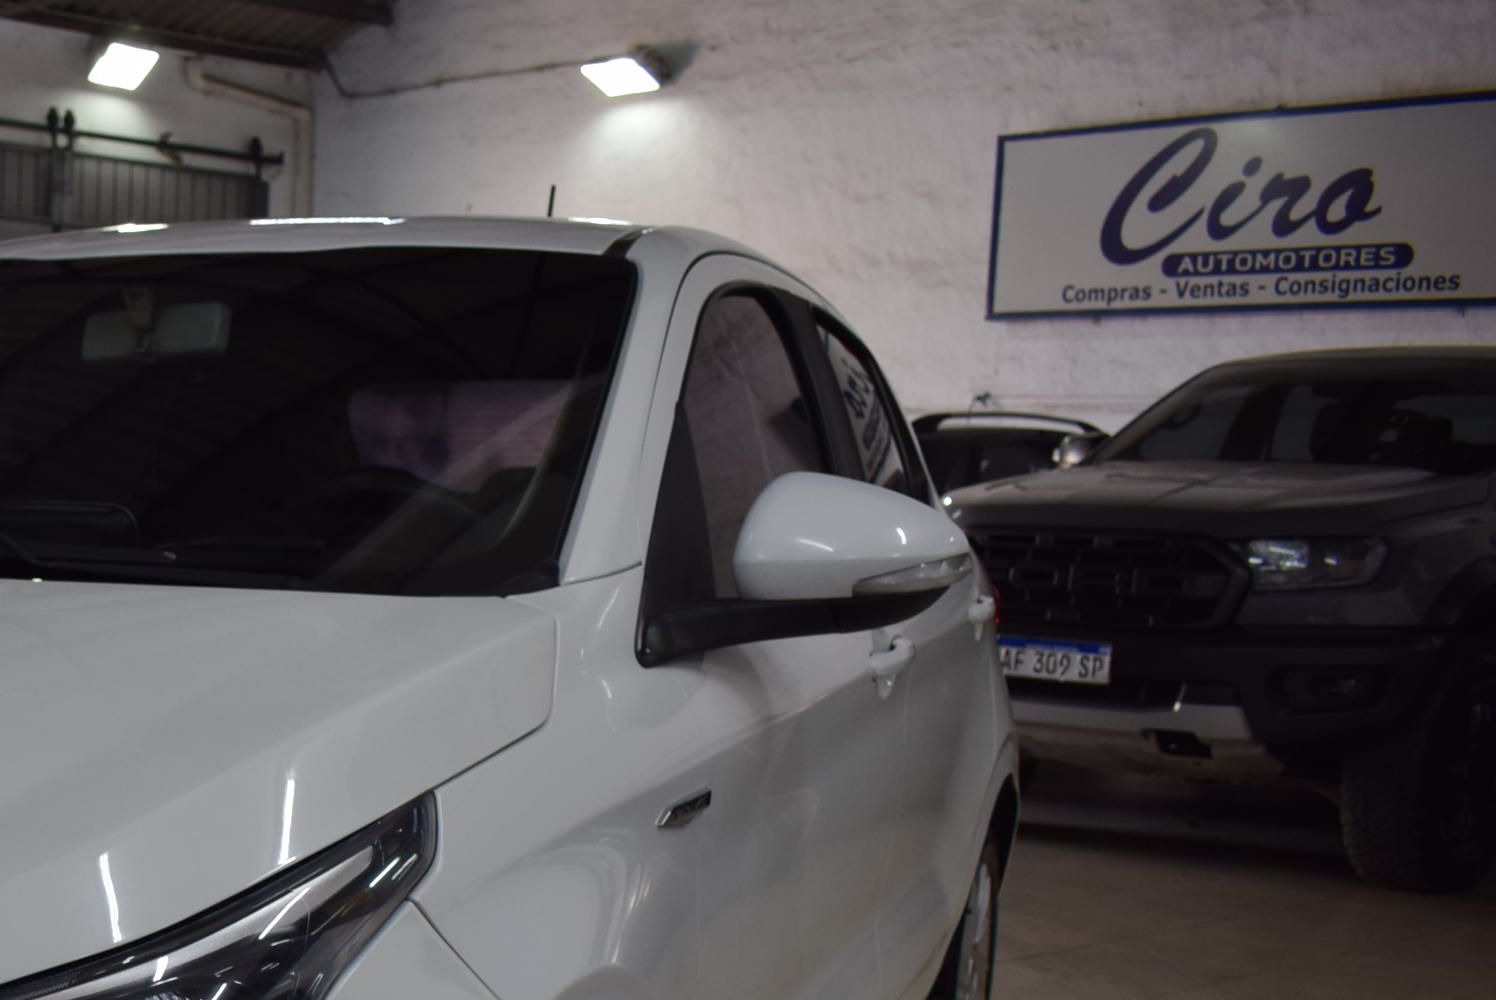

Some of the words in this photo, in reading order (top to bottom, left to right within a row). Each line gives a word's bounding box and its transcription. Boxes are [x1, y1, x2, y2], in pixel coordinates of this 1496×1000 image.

[1100, 127, 1382, 265] Ciro
[1176, 246, 1395, 275] AUTOMOTORES
[1062, 284, 1151, 306] Compras
[1176, 278, 1249, 299] Ventas
[1274, 272, 1461, 297] Consignaciones
[1001, 650, 1025, 671] AF
[1033, 651, 1071, 677] 309
[1078, 655, 1104, 679] SP
